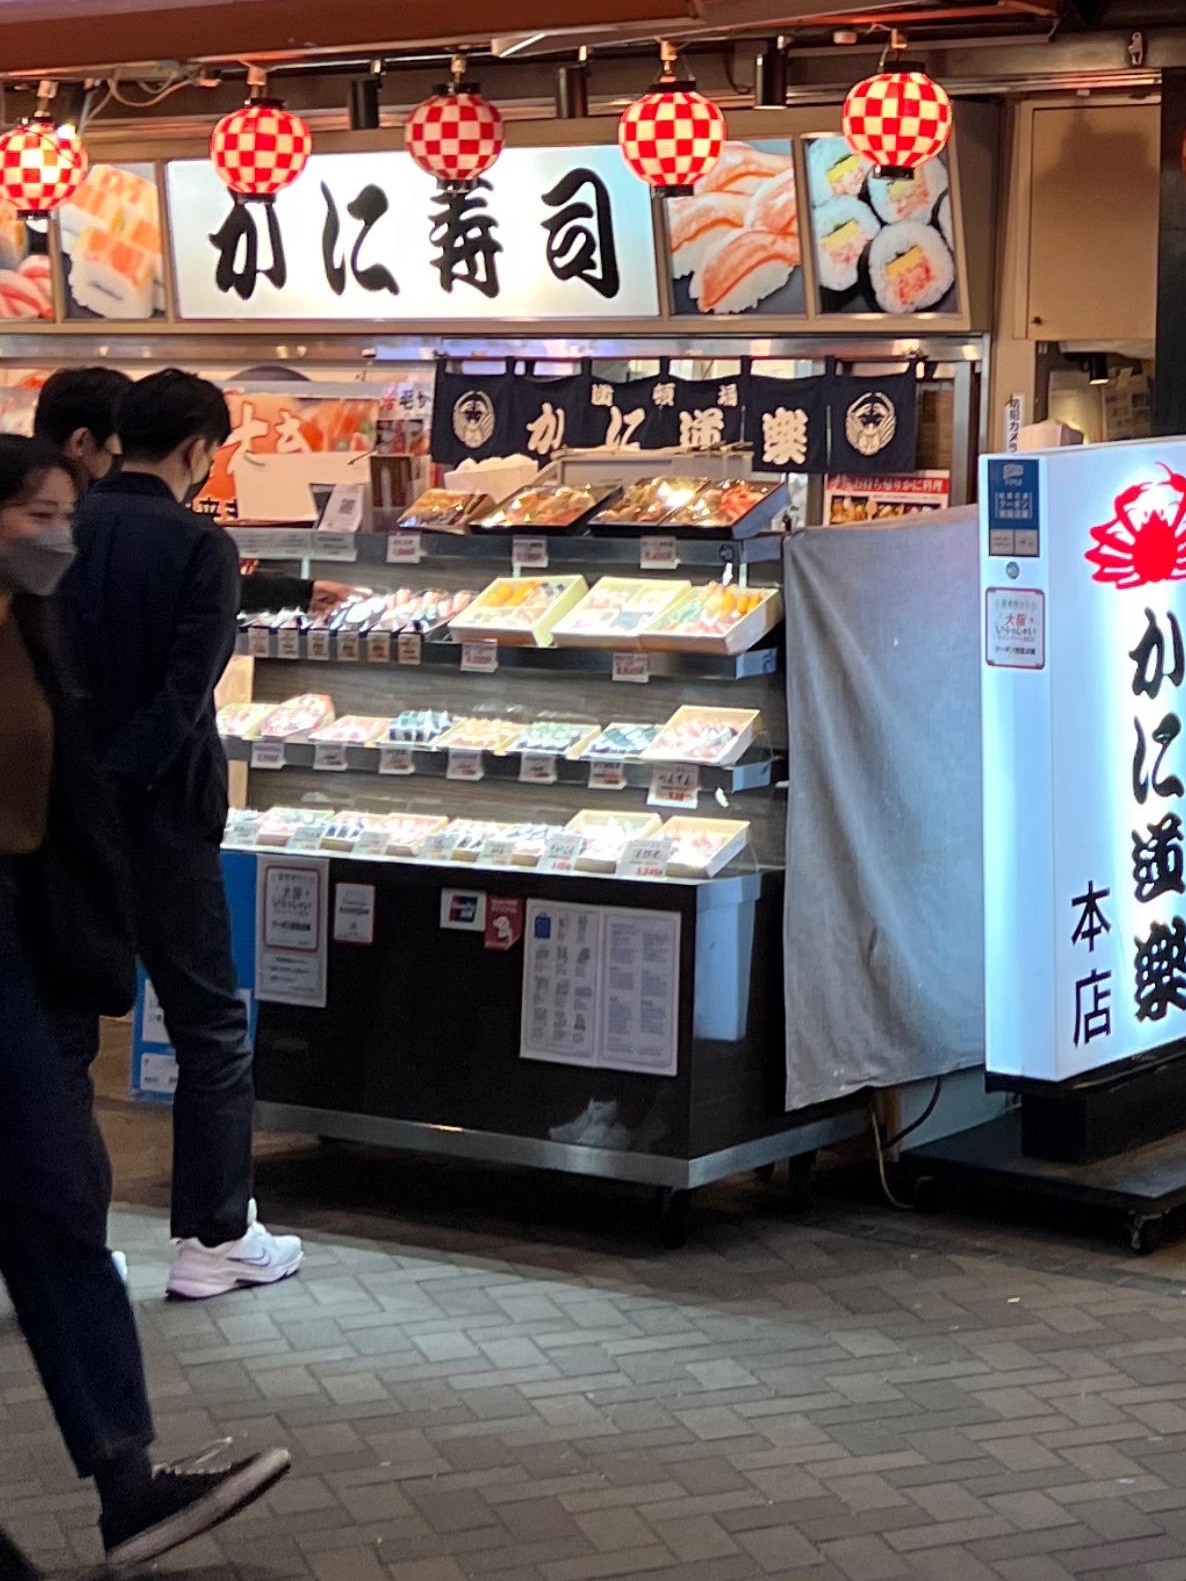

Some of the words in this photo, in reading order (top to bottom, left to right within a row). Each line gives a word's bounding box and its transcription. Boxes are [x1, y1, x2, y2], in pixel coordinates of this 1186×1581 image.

[208, 167, 620, 299] かに寿司
[1070, 880, 1112, 1048] 本店
